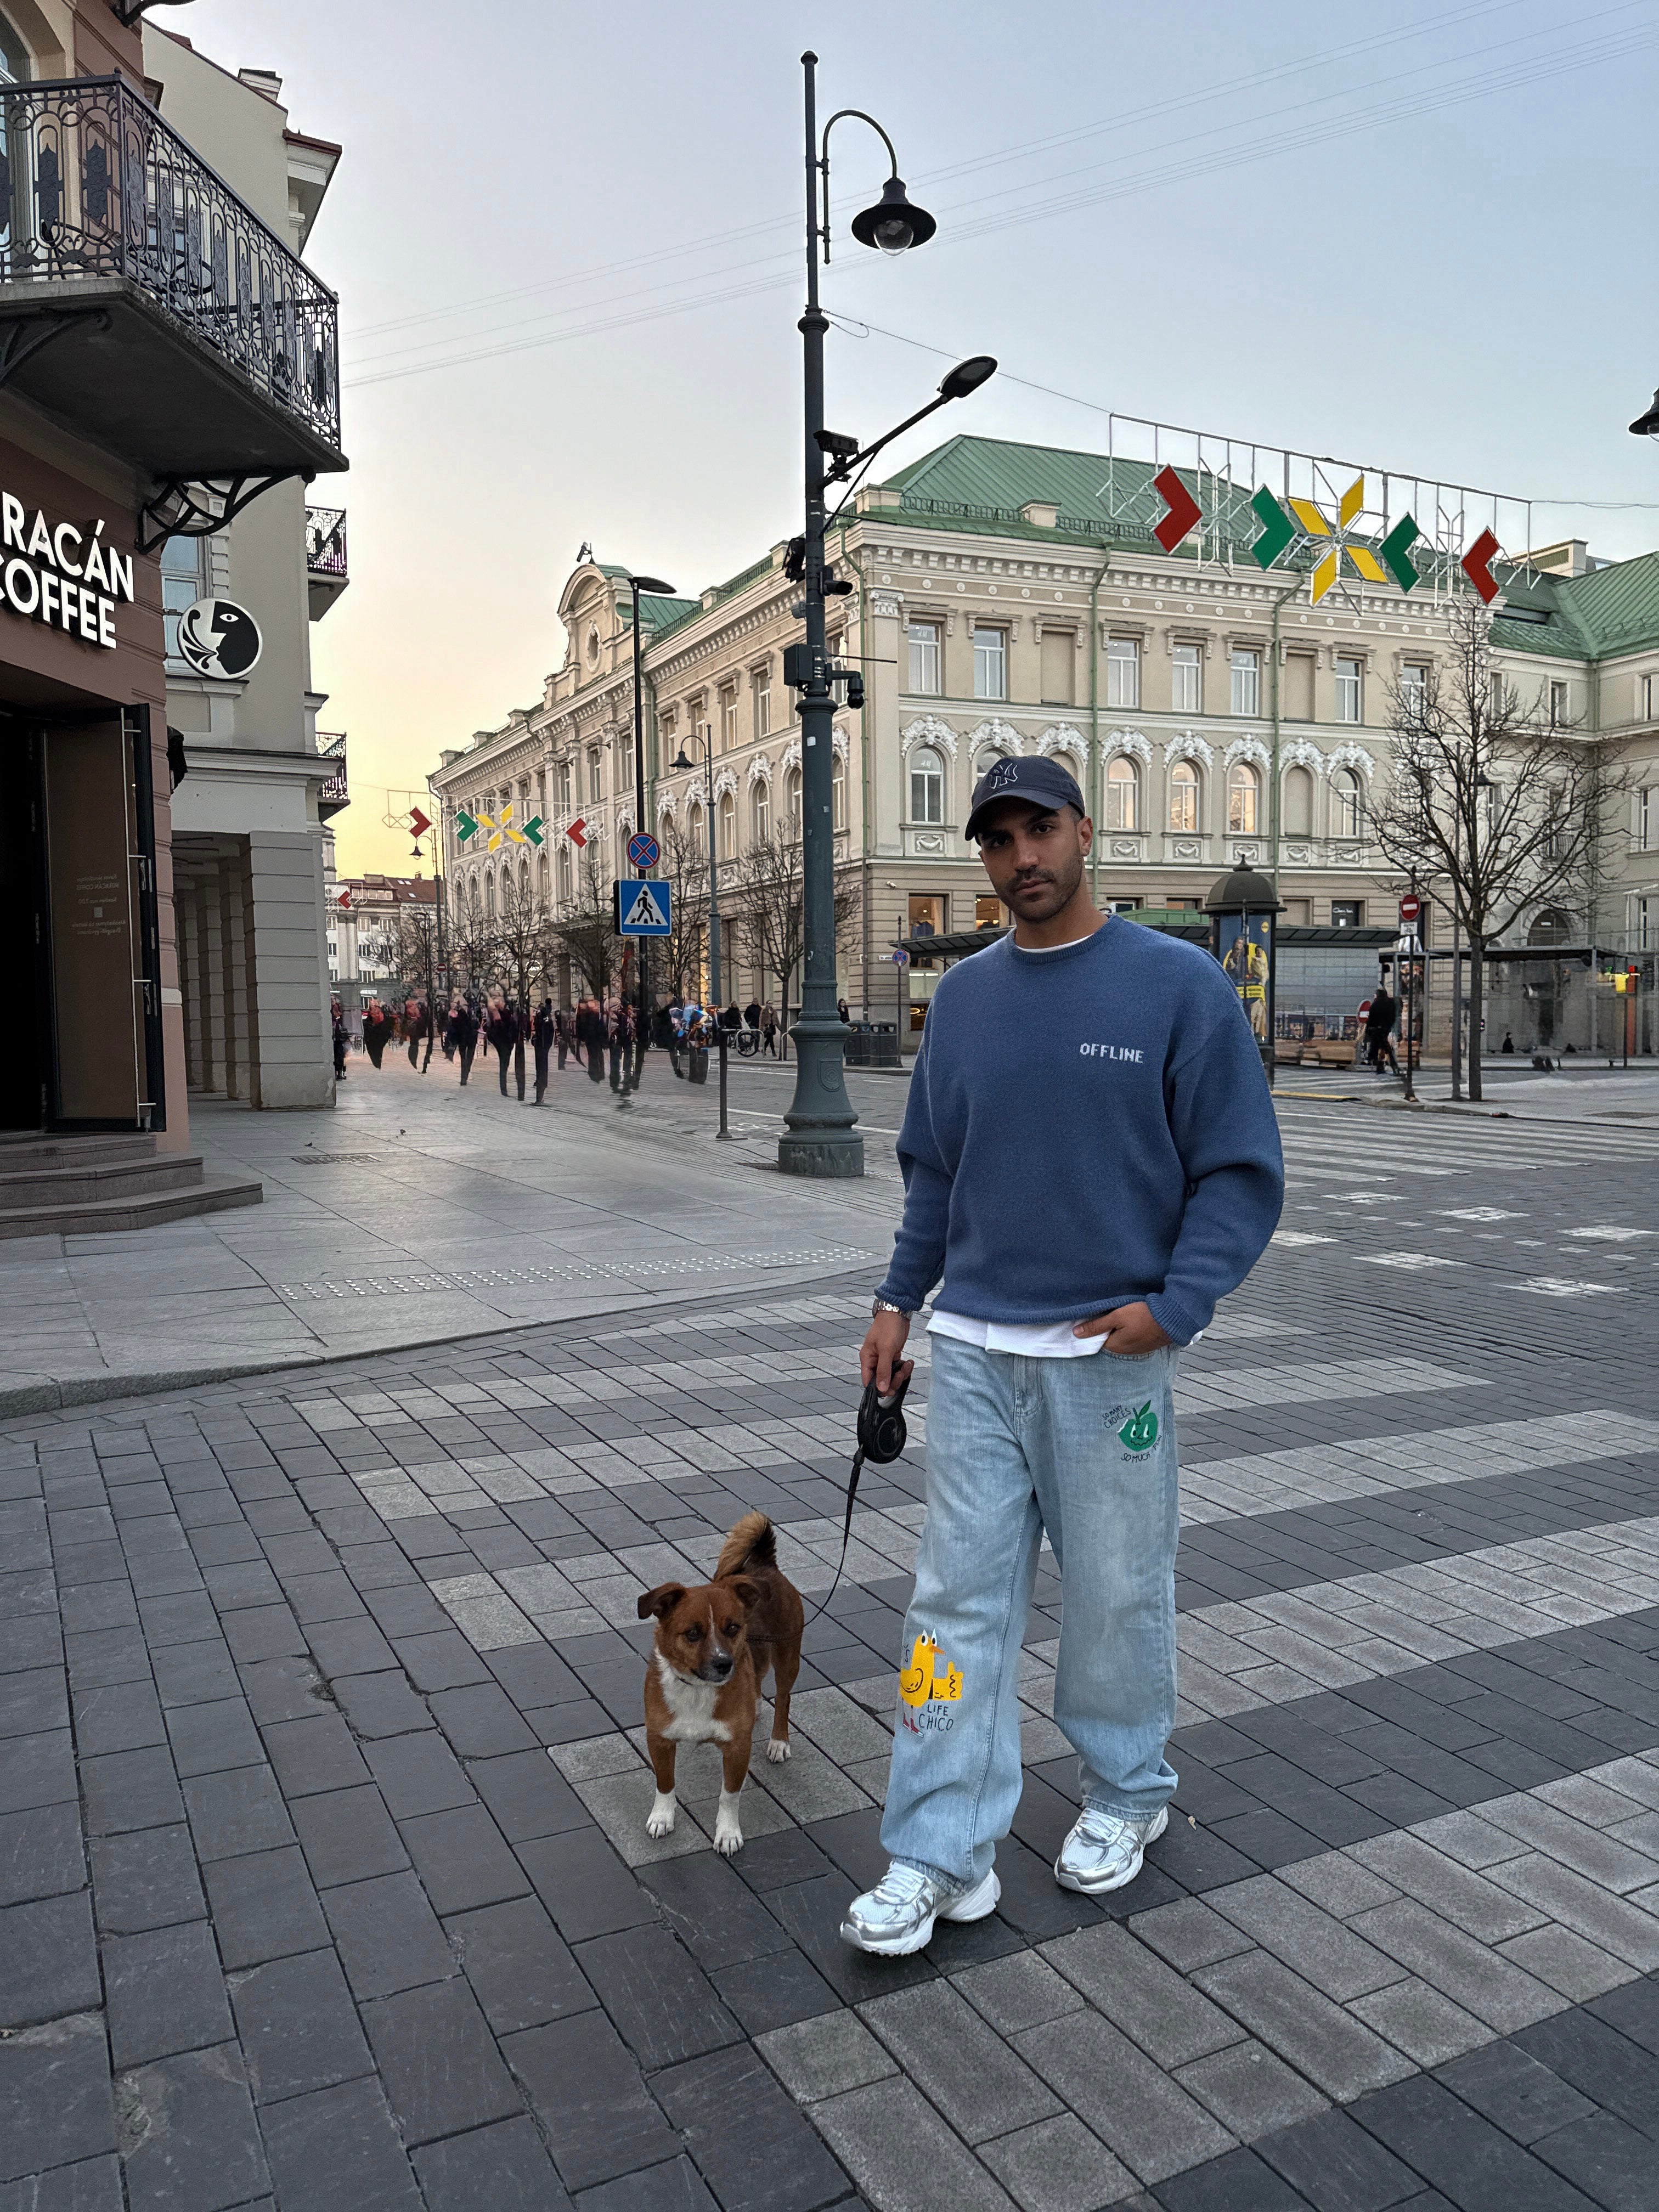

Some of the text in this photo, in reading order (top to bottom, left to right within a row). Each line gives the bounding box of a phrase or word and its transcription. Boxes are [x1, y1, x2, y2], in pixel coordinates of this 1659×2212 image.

[0, 554, 116, 648] OFFEE
[1080, 1043, 1144, 1064] OFFLINE
[1104, 1408, 1131, 1429] CHOICES
[1109, 1405, 1122, 1416] MANY
[928, 1704, 949, 1717] LIFE
[918, 1713, 954, 1731] CHICO
